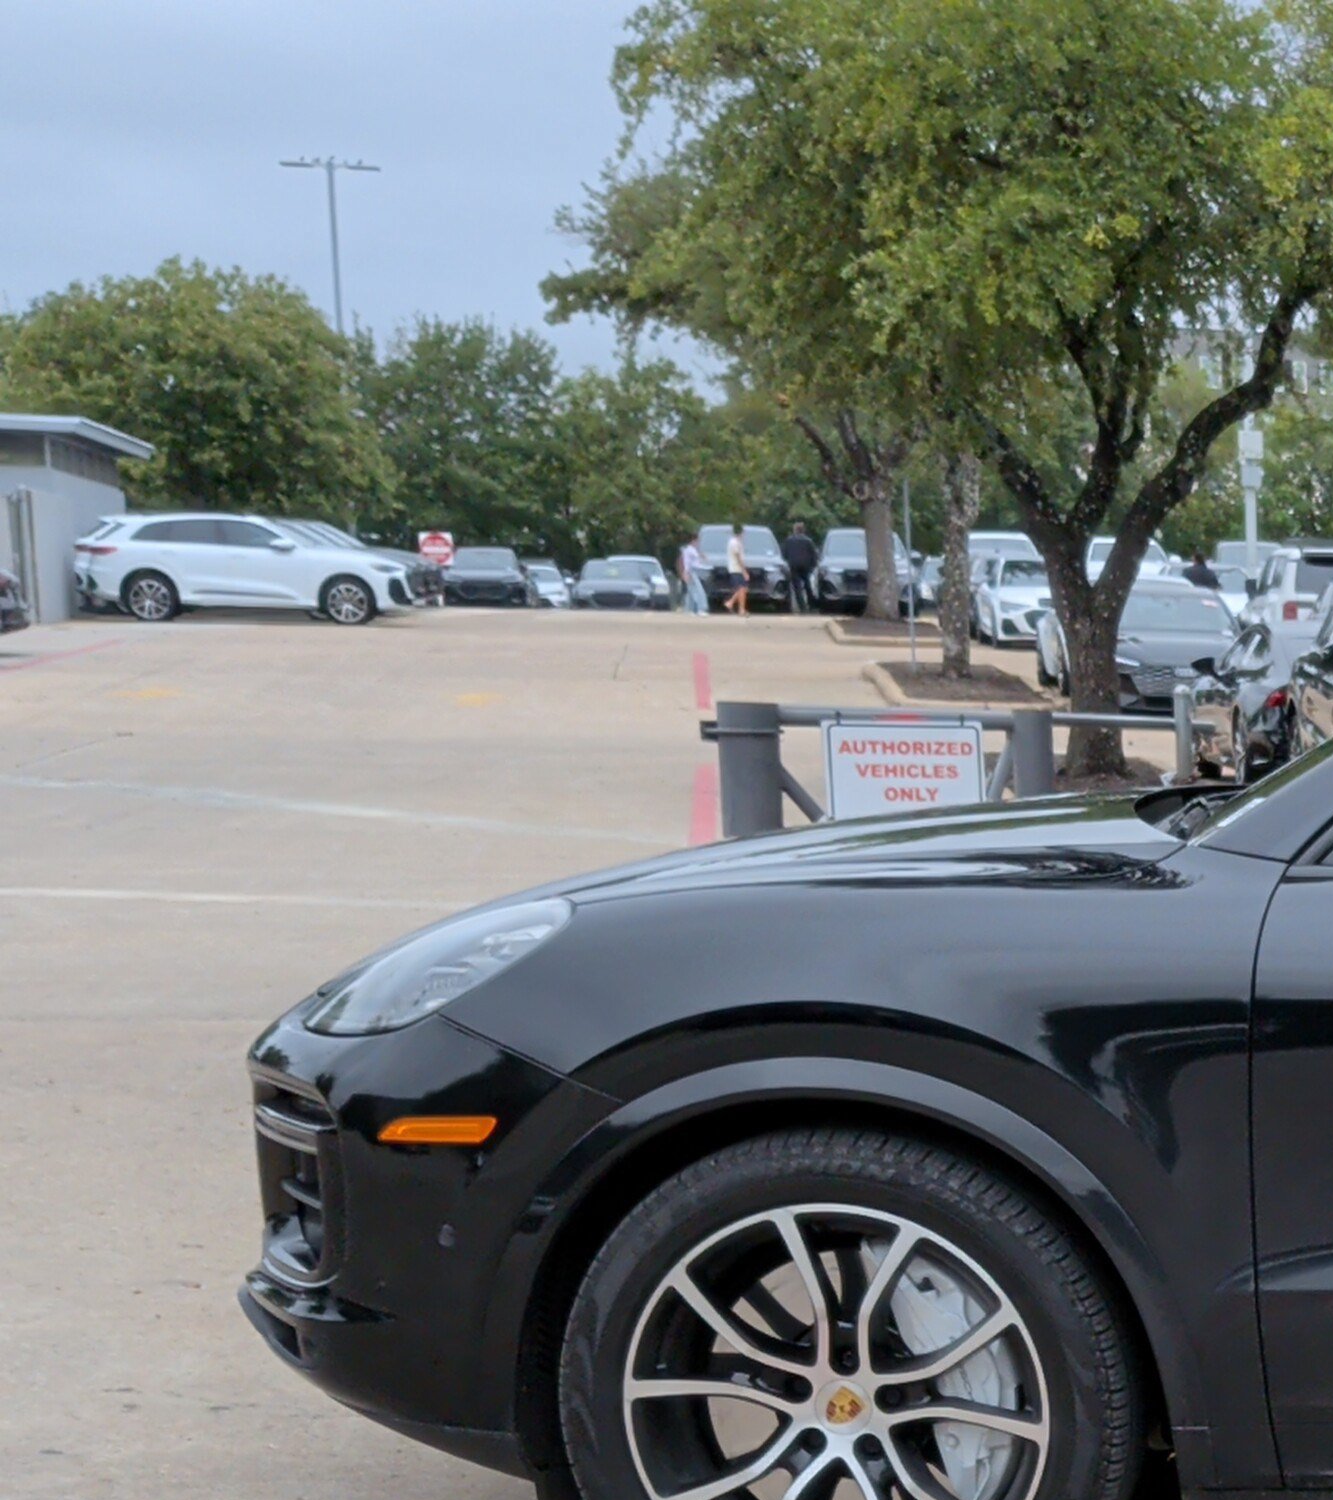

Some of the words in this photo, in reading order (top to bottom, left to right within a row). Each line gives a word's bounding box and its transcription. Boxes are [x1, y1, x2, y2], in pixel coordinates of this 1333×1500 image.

[838, 739, 973, 756] AUTHORIZED
[855, 763, 959, 779] VEHICLES
[884, 786, 939, 802] ONLY
